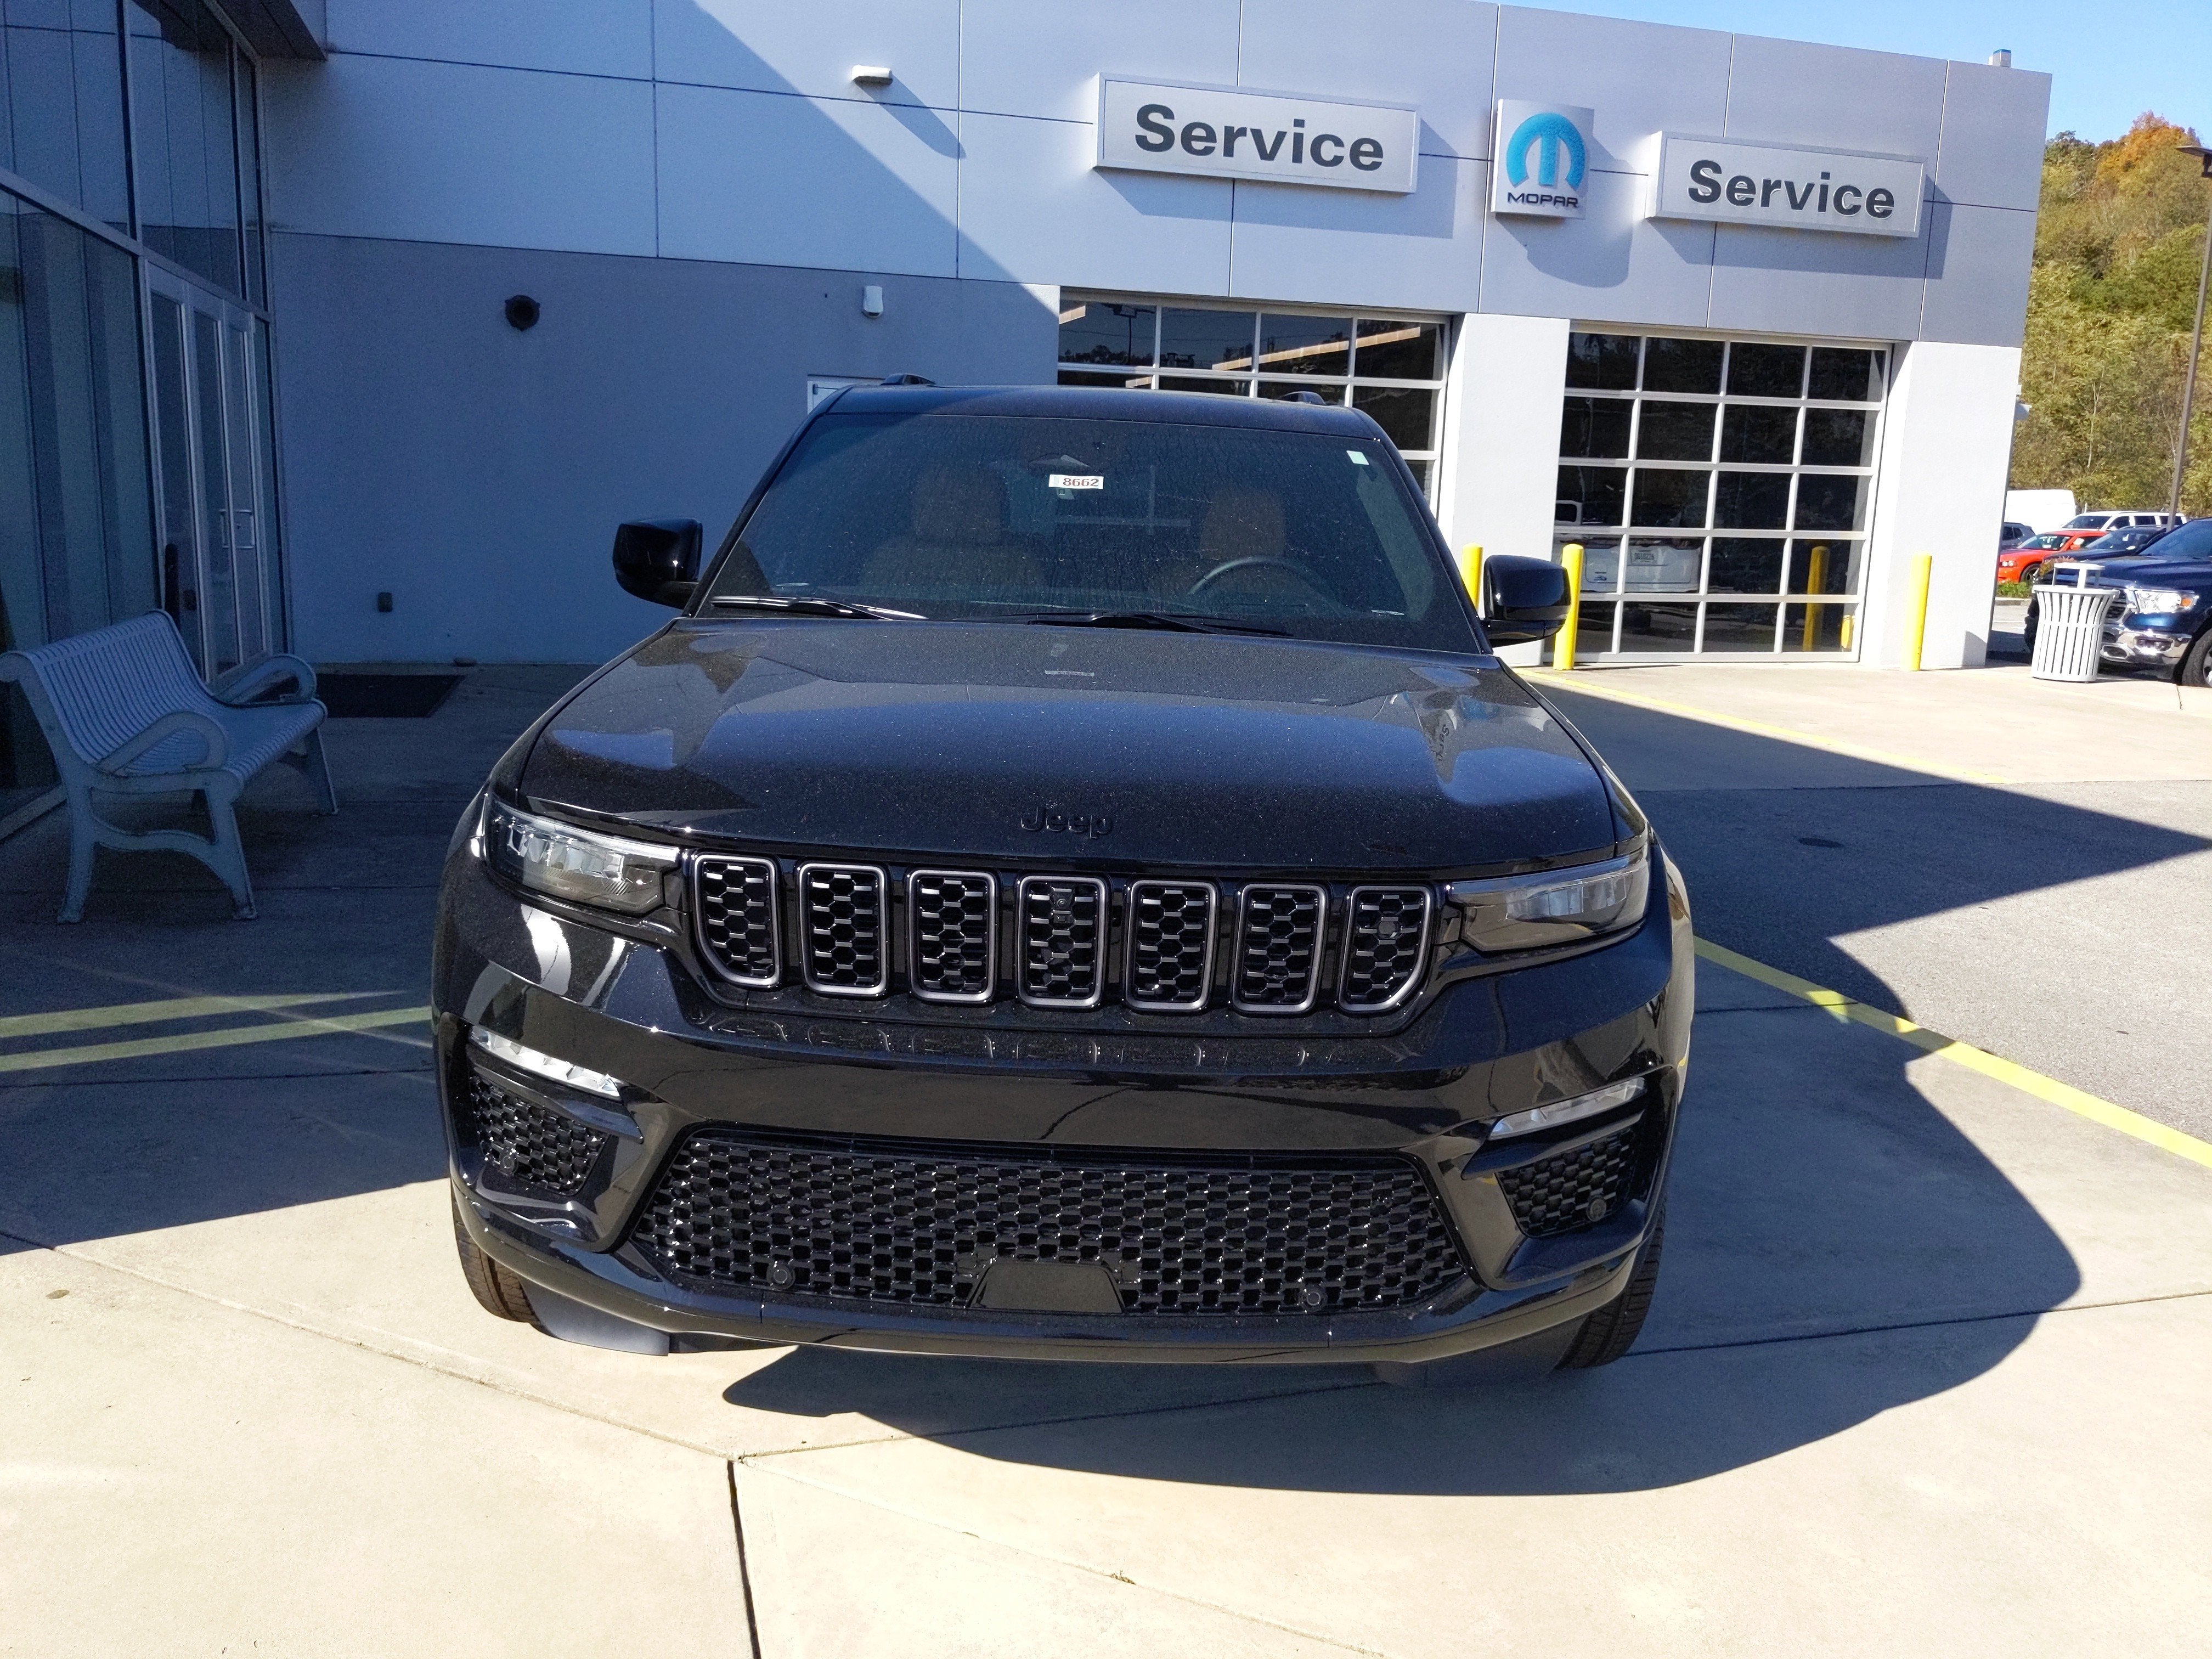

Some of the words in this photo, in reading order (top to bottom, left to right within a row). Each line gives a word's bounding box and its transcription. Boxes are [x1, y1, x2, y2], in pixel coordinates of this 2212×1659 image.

[1135, 104, 1383, 171] Service
[1508, 192, 1578, 207] MOPAR
[1688, 160, 1894, 219] Service
[1063, 478, 1099, 487] 8662
[1021, 806, 1113, 839] Jeep
